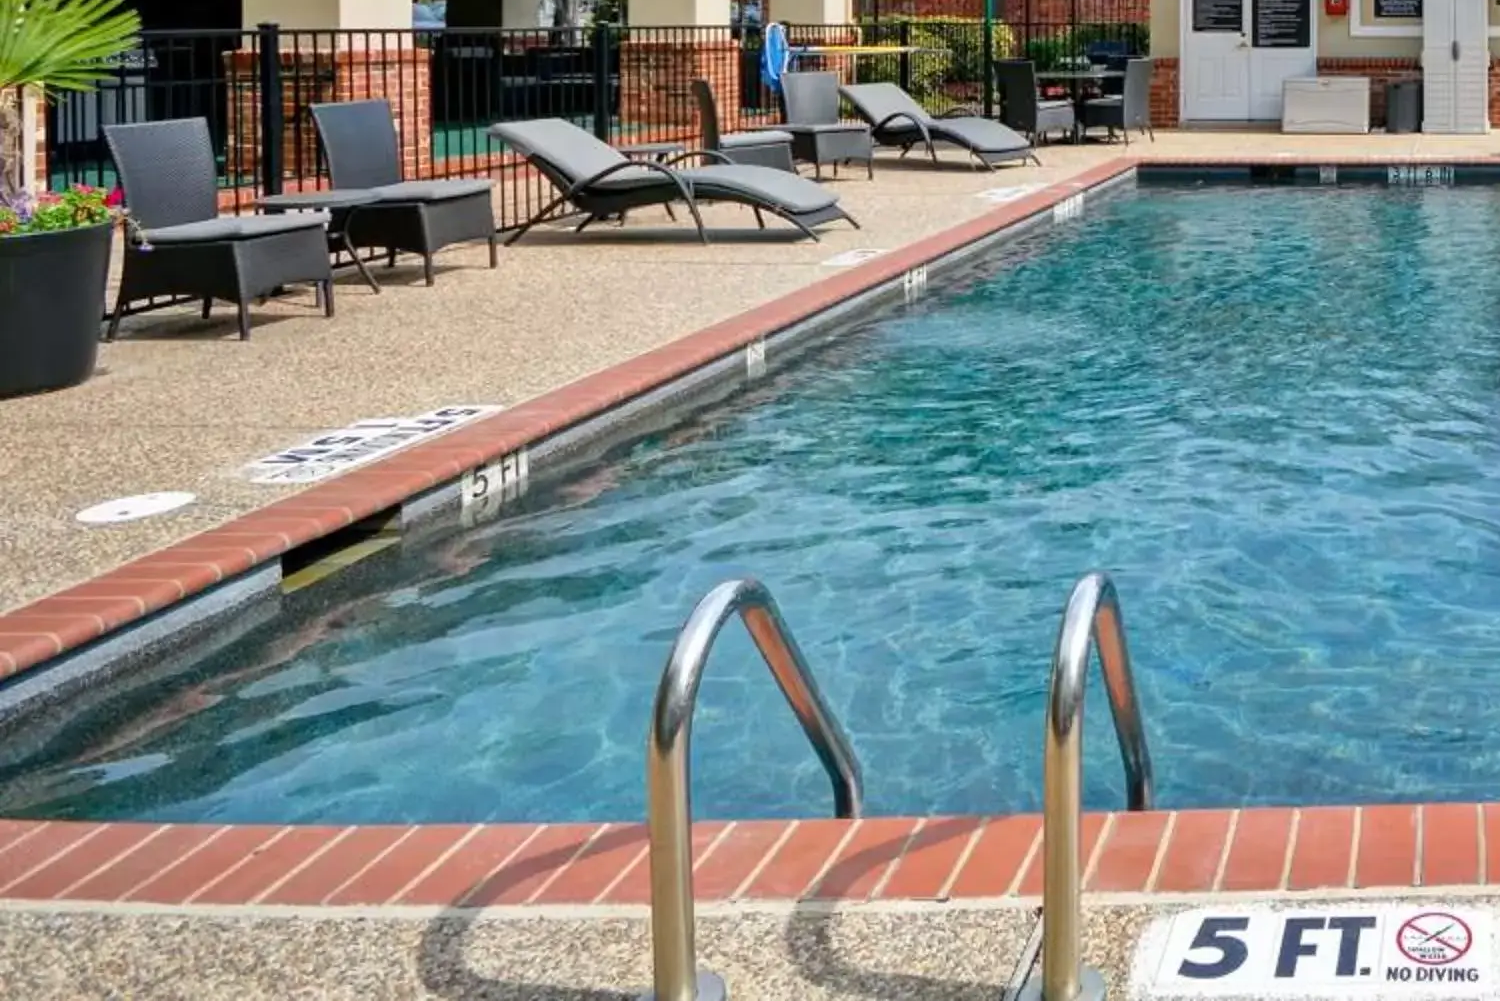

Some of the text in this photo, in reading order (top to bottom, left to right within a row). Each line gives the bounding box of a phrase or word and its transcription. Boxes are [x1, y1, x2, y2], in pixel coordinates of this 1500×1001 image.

[472, 465, 489, 498] 5
[1177, 916, 1377, 980] 5 FT.
[1386, 967, 1479, 983] NO DIVING
